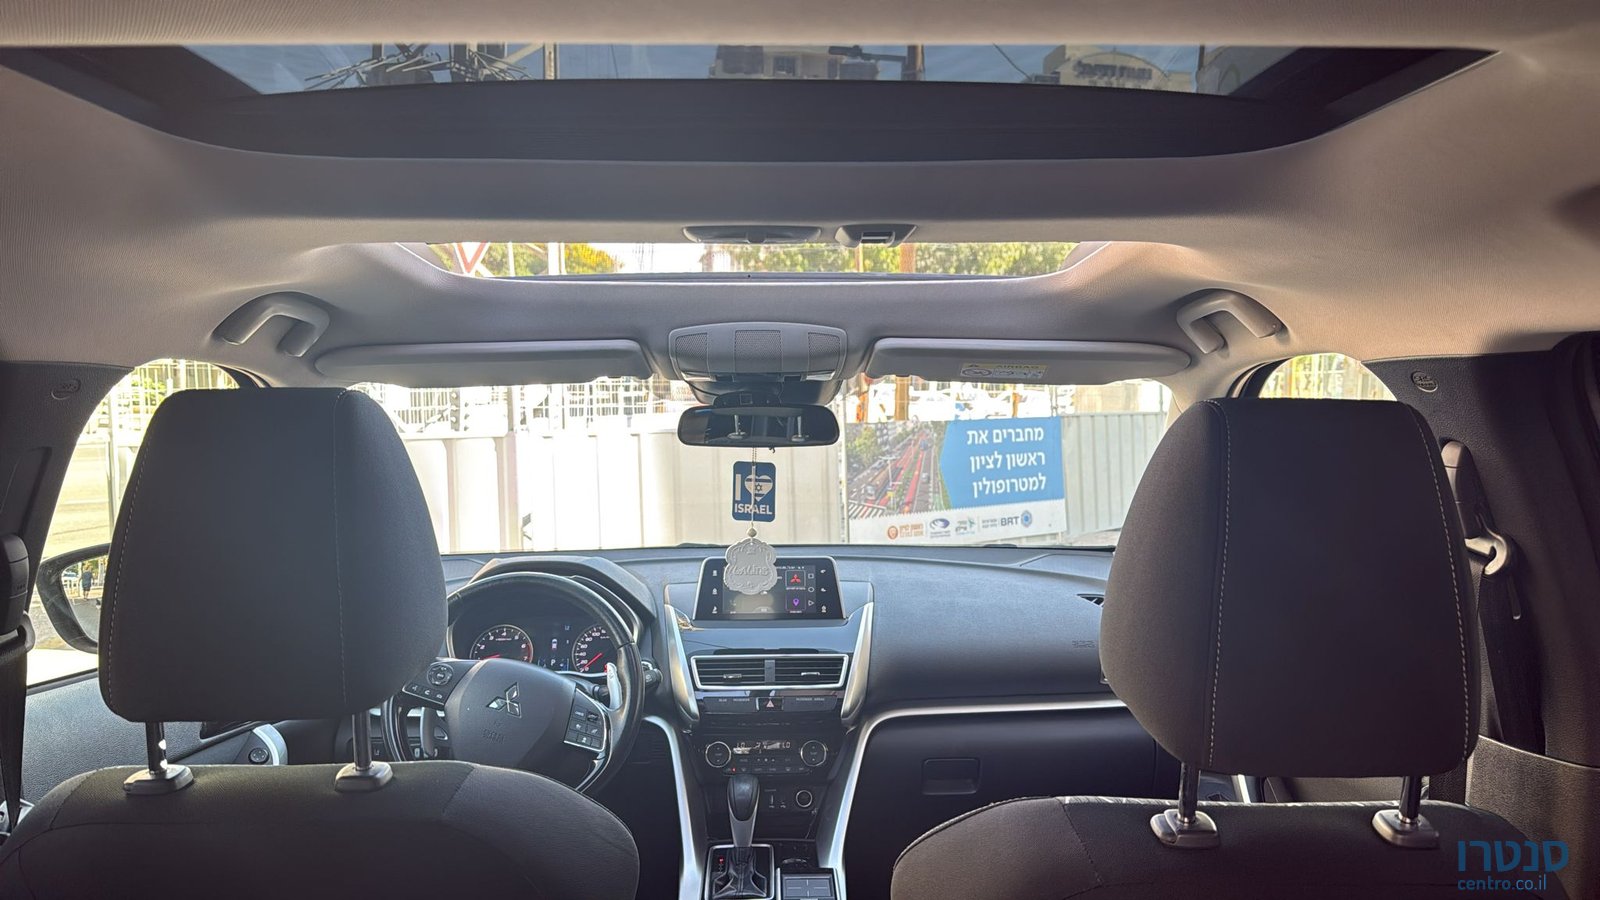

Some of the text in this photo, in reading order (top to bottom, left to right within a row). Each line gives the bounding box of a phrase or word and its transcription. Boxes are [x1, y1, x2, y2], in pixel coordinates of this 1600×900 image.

[966, 427, 1045, 445] מחברים את
[969, 451, 1046, 473] ראשון לציון
[735, 473, 742, 501] I
[972, 474, 1047, 498] למטרופולין
[734, 503, 773, 515] ISRAEL
[1000, 515, 1020, 527] BRT
